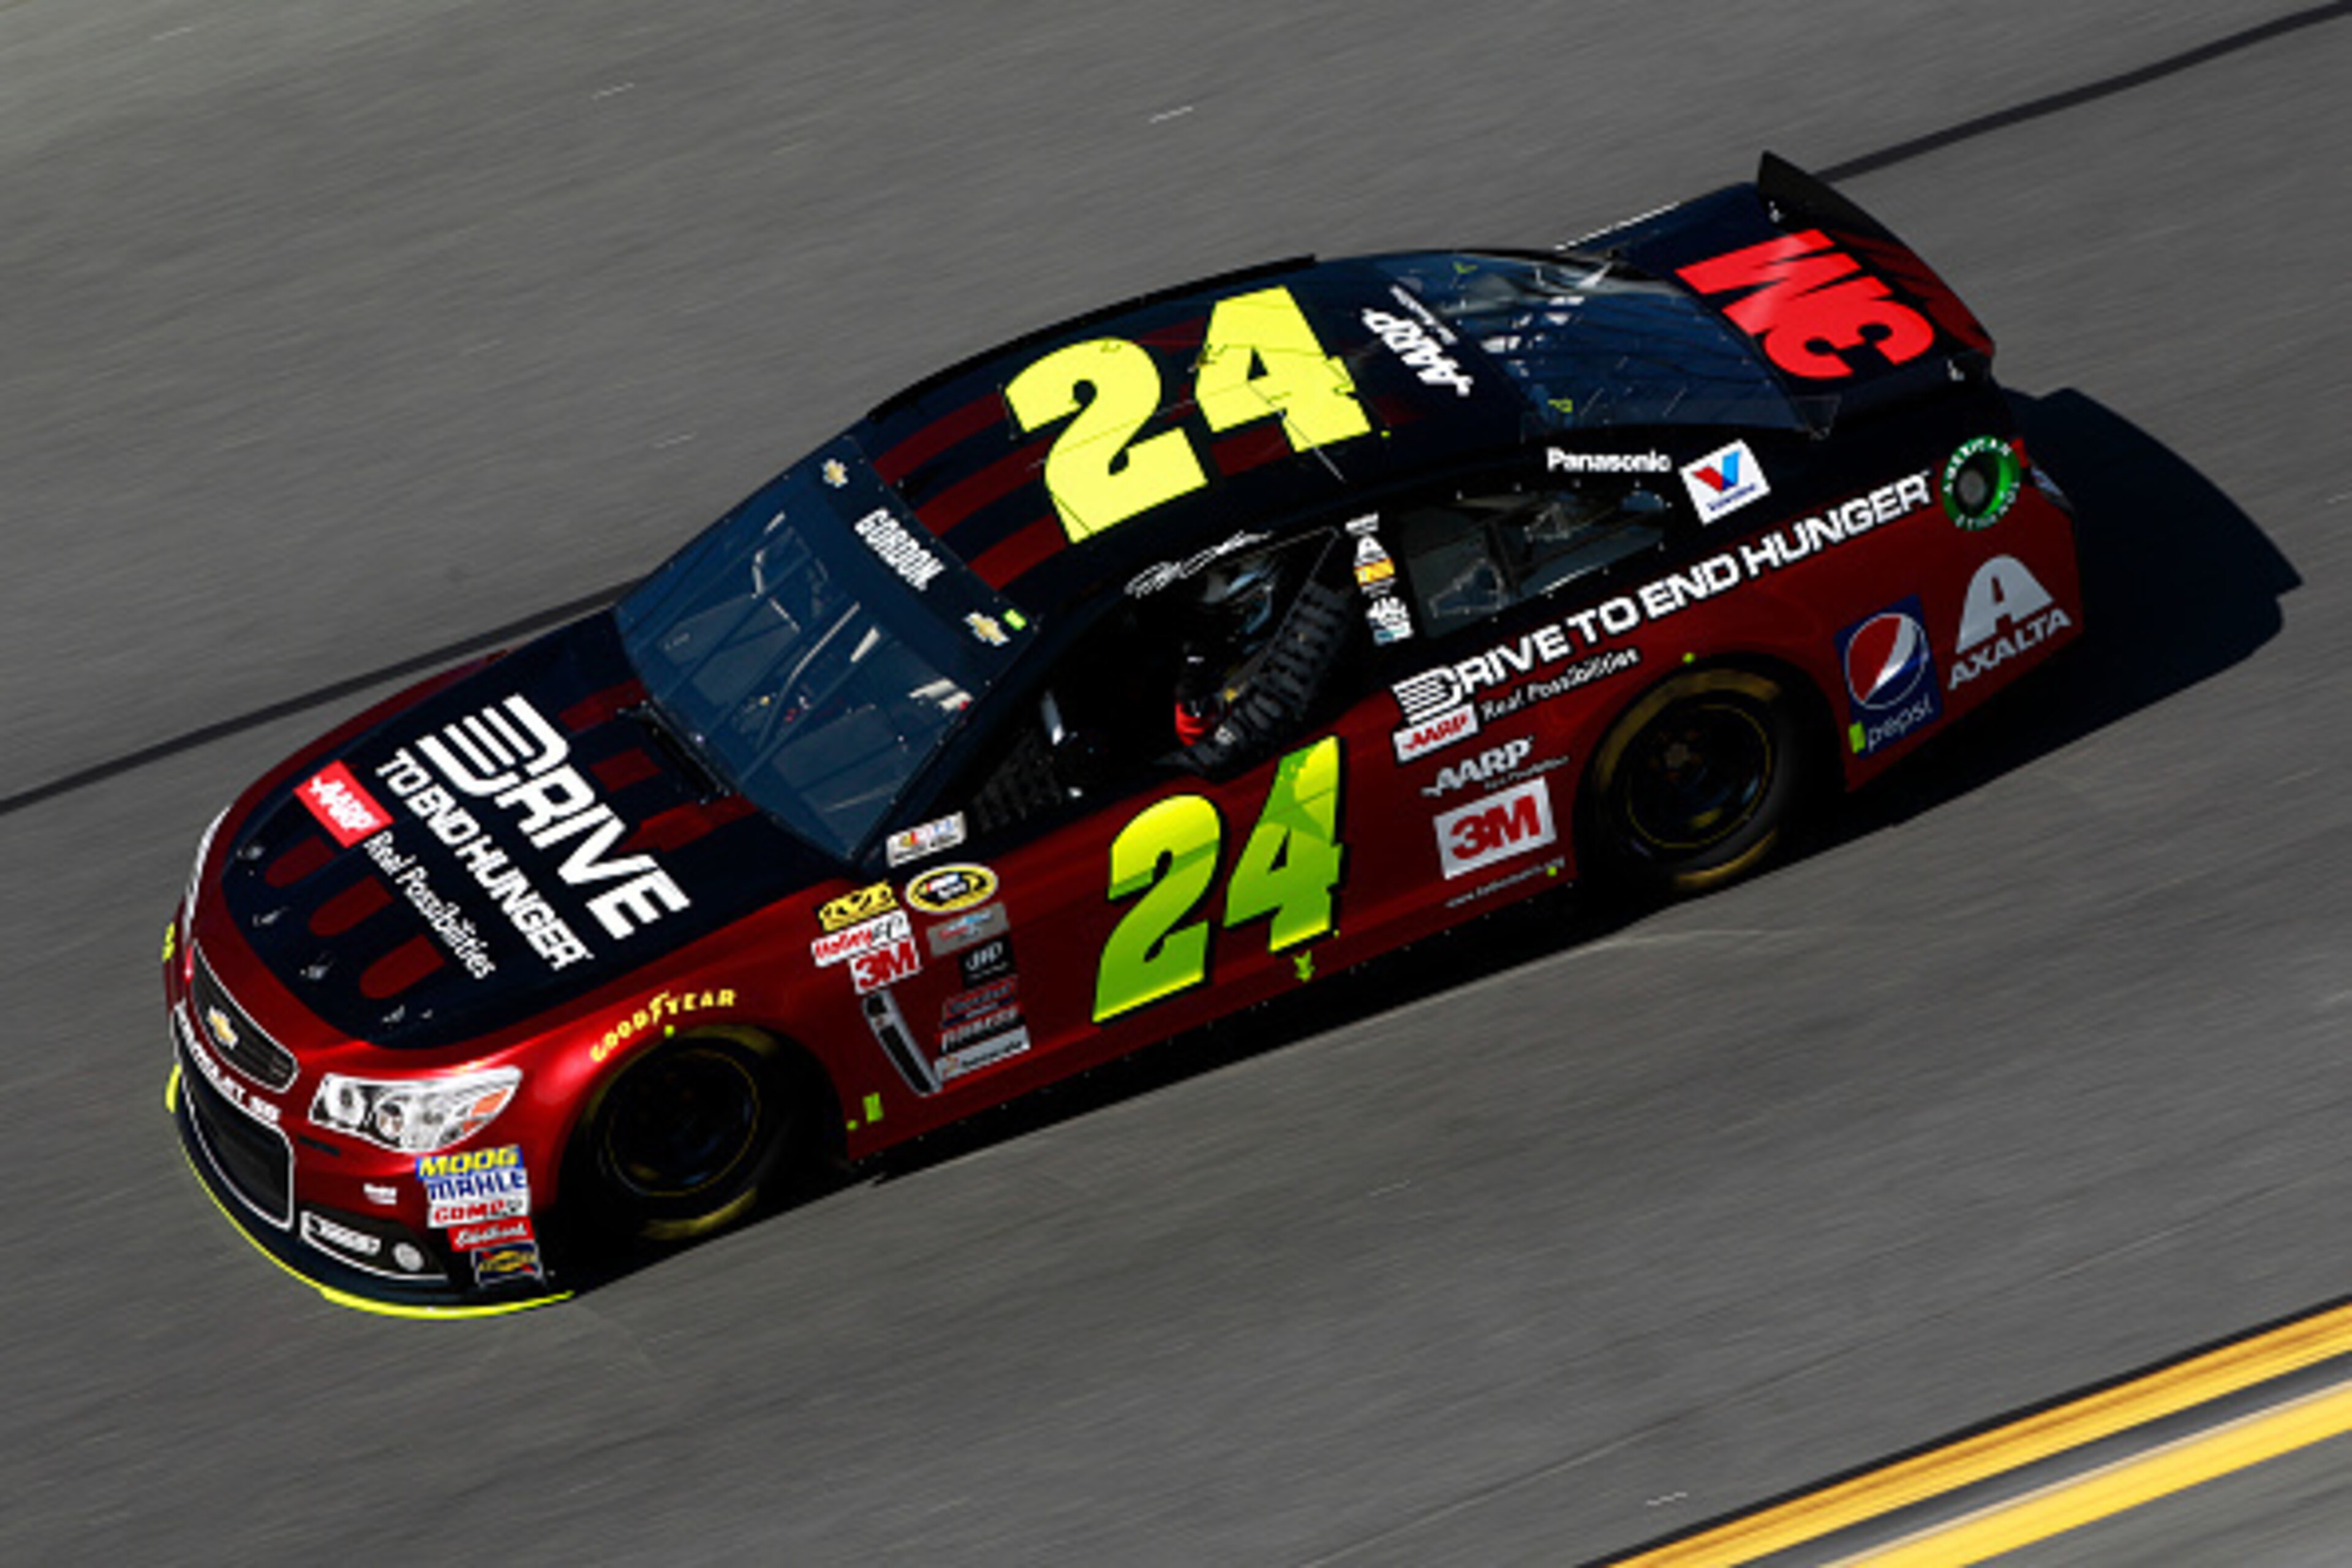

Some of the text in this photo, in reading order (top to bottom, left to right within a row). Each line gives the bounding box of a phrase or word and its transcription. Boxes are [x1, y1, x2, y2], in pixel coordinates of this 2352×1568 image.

[1675, 228, 1936, 379] 3M
[1361, 308, 1474, 396] AARP
[1005, 285, 1372, 545] 24
[1546, 447, 1672, 472] Panasonic
[854, 507, 946, 592] GORDON
[1392, 471, 1933, 725] DRIVE TO END HUNGER
[1480, 648, 1641, 720] Real Possibilities
[1947, 608, 2071, 691] AXALTA
[1402, 712, 1469, 751] AARP
[1867, 692, 1934, 753] pepsi
[307, 775, 382, 831] AARP
[1421, 737, 1532, 797] AARP
[414, 693, 692, 940] DRIVE
[1449, 794, 1542, 860] 3M
[375, 747, 592, 971] TO END HUNGER
[1092, 734, 1343, 1023] 24
[363, 830, 496, 980] Real Possibilities
[854, 937, 918, 988] 3M
[589, 989, 737, 1062] GOODYEAR
[419, 1145, 519, 1177] MOOG
[428, 1170, 527, 1200] MAHLE
[434, 1199, 504, 1224] COMP
